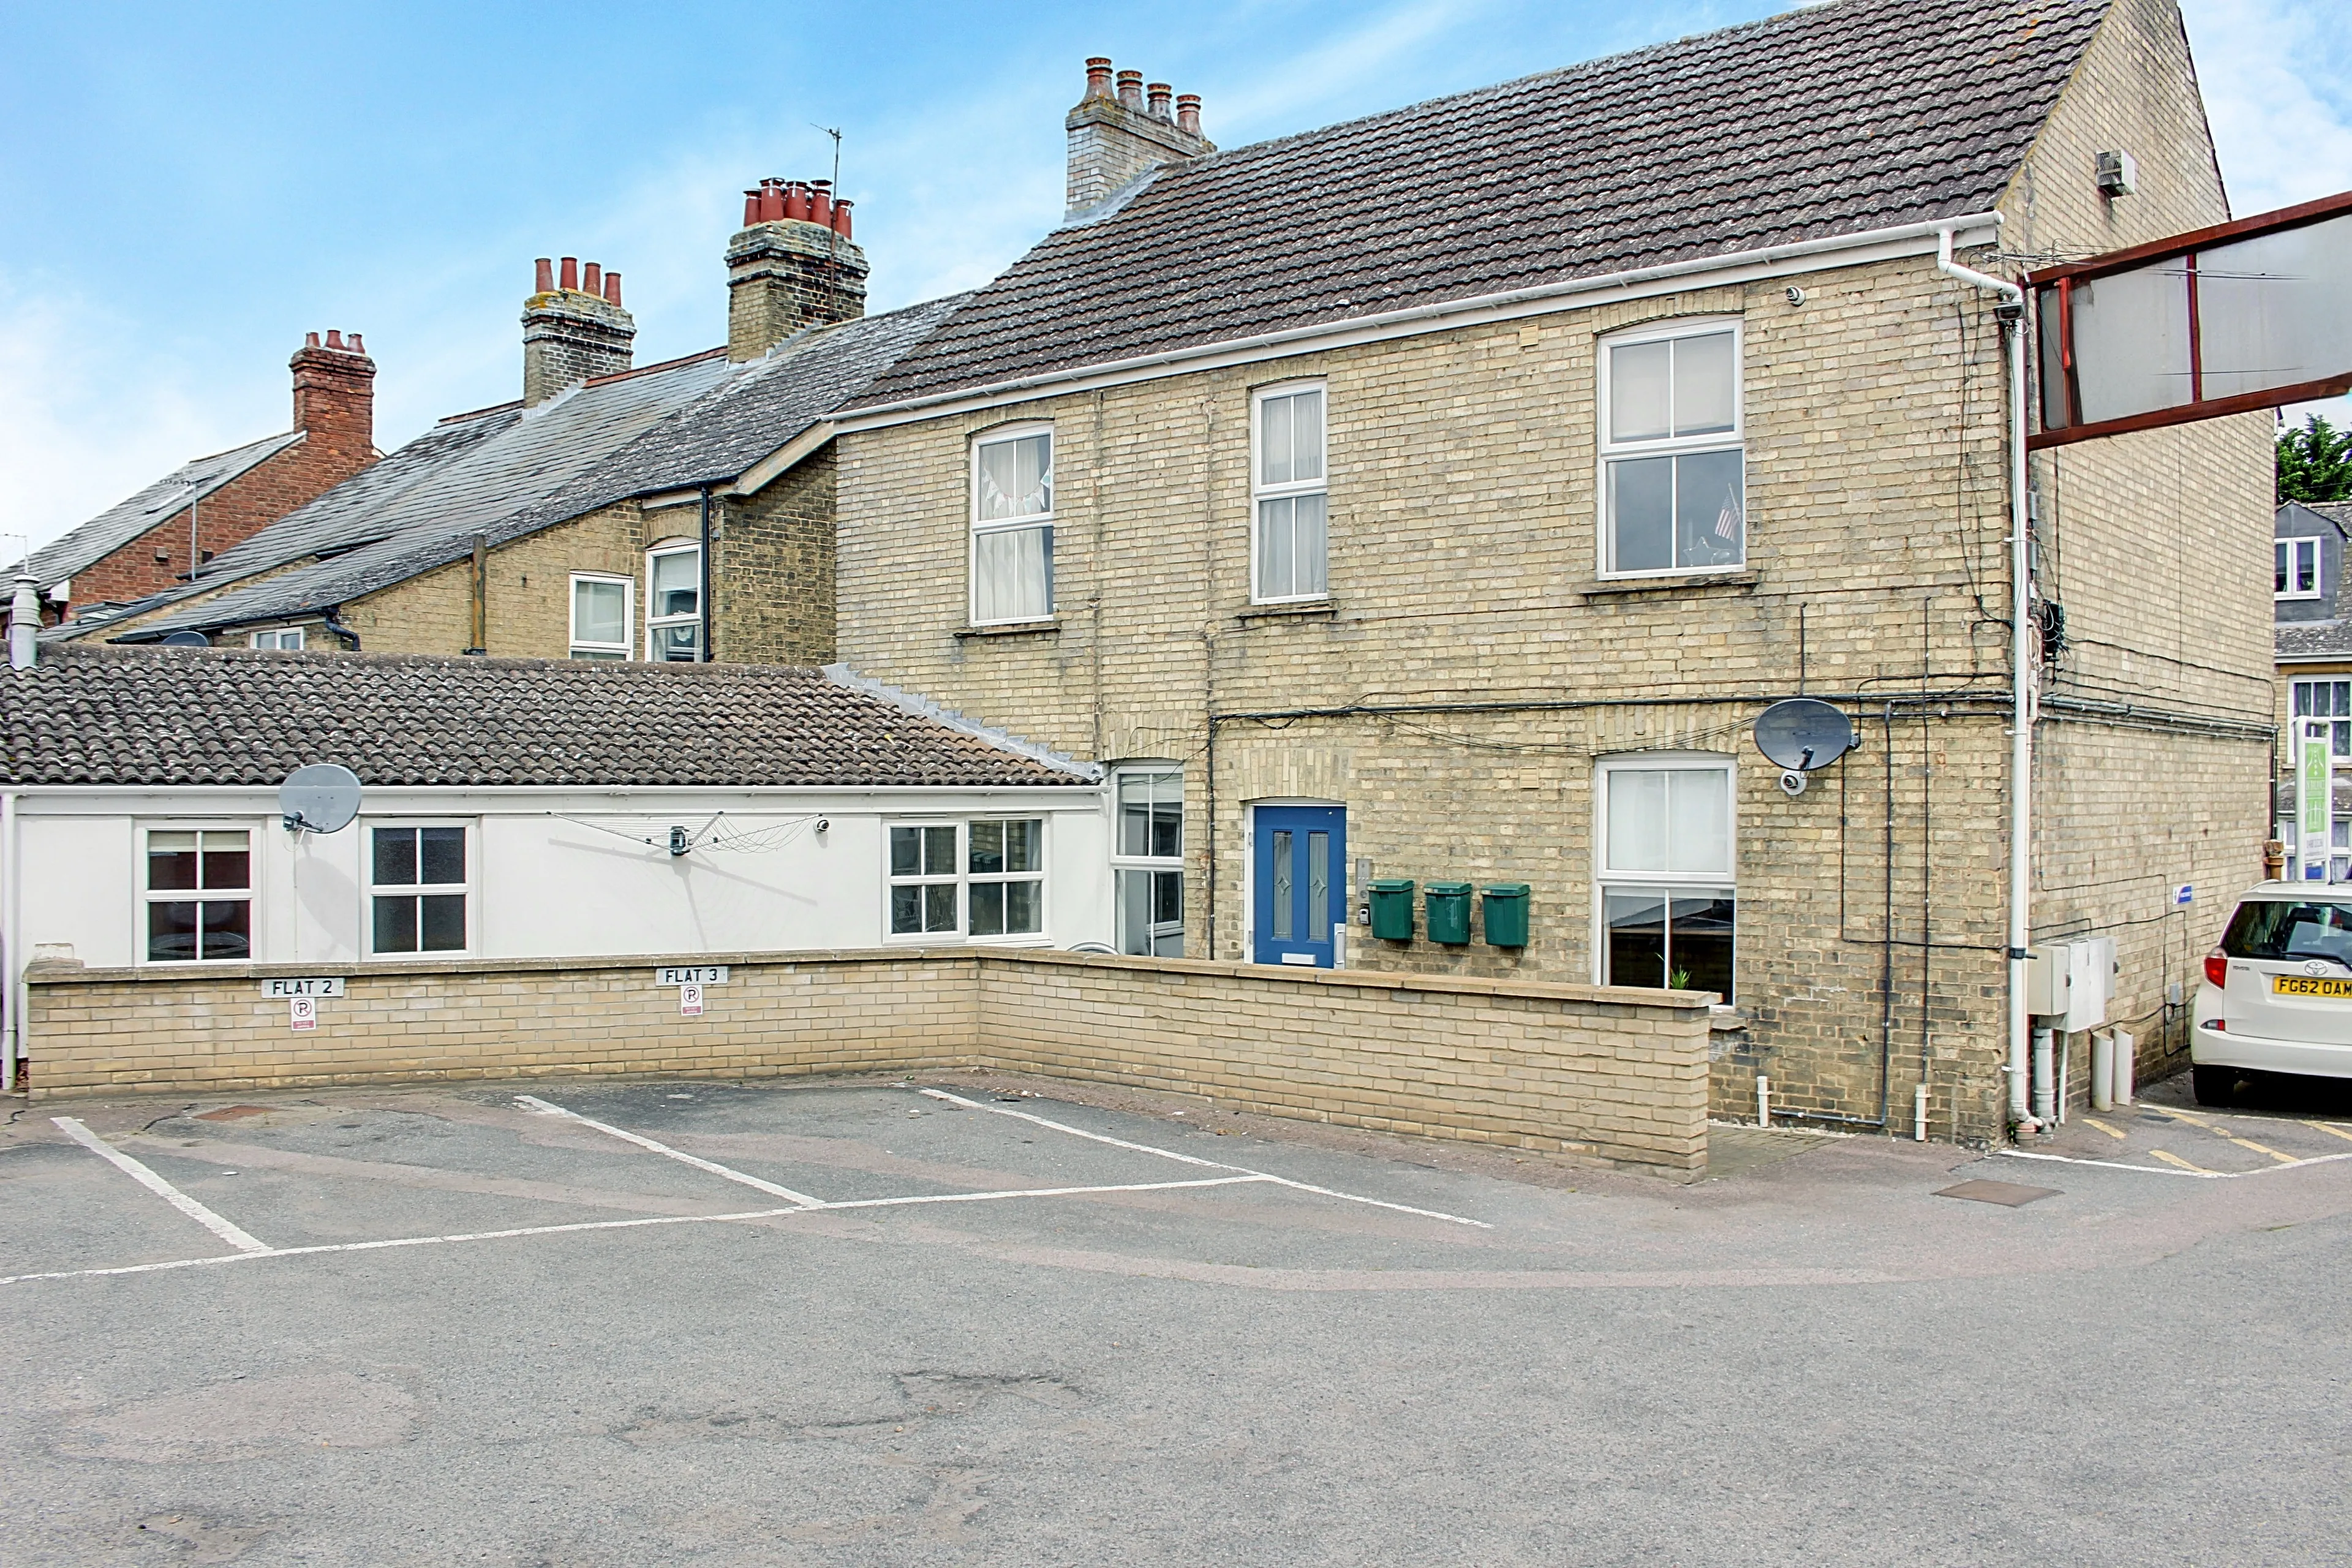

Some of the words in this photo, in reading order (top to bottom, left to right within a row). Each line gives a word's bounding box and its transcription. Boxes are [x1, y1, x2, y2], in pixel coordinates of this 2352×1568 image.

[666, 969, 702, 982] FLAT
[709, 968, 717, 981] 3
[273, 981, 314, 995] FLAT
[322, 980, 332, 993] 2
[2279, 979, 2318, 993] FG62
